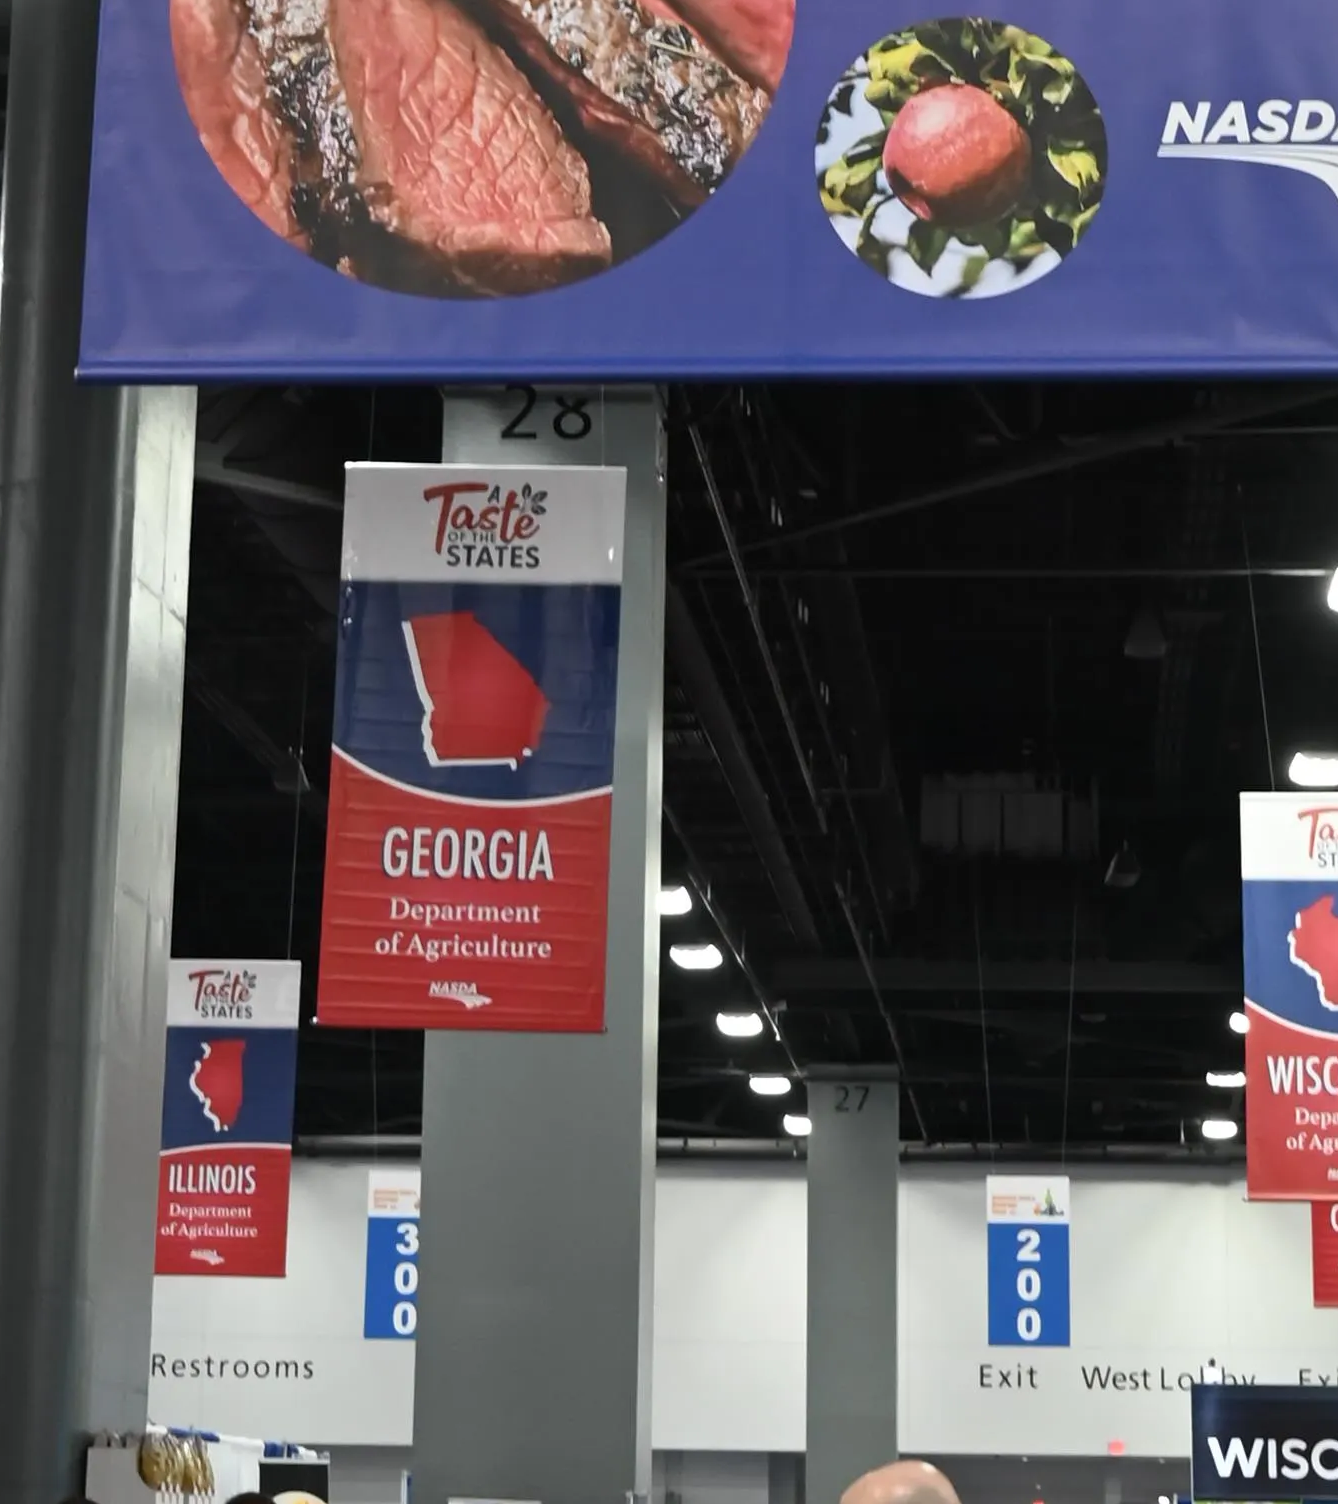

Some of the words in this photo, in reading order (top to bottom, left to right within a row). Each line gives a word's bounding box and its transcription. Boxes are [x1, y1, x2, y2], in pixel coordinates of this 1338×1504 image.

[500, 384, 592, 440] 28
[487, 484, 501, 503] A
[423, 481, 540, 555] Taste
[446, 544, 540, 569] STATES
[382, 826, 554, 881] GEORGIA
[389, 896, 541, 928] Department
[374, 931, 404, 956] of
[407, 932, 552, 963] Agriculture
[201, 1005, 253, 1019] STATES
[834, 1085, 870, 1113] 27
[1286, 1132, 1307, 1151] of
[169, 1164, 256, 1195] ILLINOIS
[169, 1202, 252, 1221] Department
[161, 1221, 177, 1236] of
[178, 1222, 258, 1240] Agriculture
[393, 1222, 420, 1335] 300
[1016, 1228, 1041, 1341] 200
[151, 1353, 314, 1379] Restrooms
[979, 1362, 1038, 1389] Exit
[1081, 1365, 1151, 1391] West
